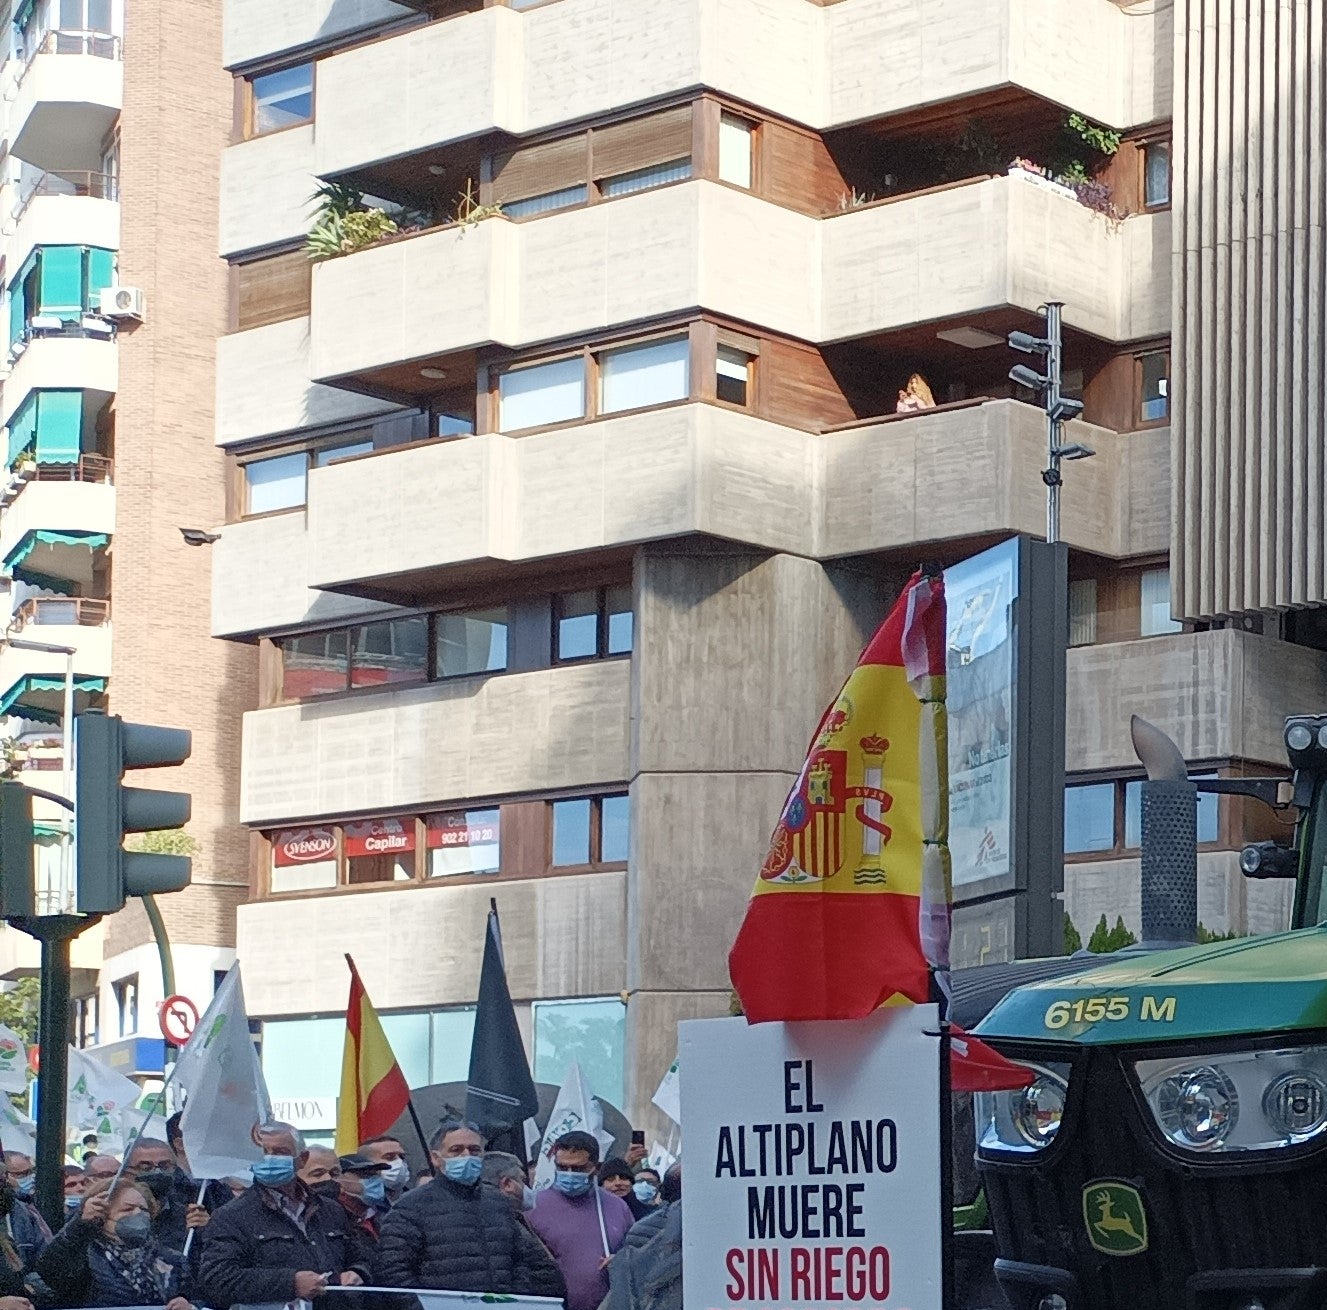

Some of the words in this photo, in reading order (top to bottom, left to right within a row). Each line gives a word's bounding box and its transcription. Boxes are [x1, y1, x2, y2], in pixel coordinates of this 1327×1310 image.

[365, 835, 407, 851] Capilar
[441, 831, 457, 844] 902
[458, 830, 468, 843] 21
[482, 828, 493, 841] 20
[1044, 996, 1130, 1030] 6155
[1140, 996, 1177, 1021] M
[783, 1059, 824, 1114] EL
[715, 1118, 898, 1178] ALTIPLANO
[747, 1182, 866, 1240] MUERE
[725, 1247, 779, 1302] SIN
[790, 1245, 890, 1302] RIEGO
